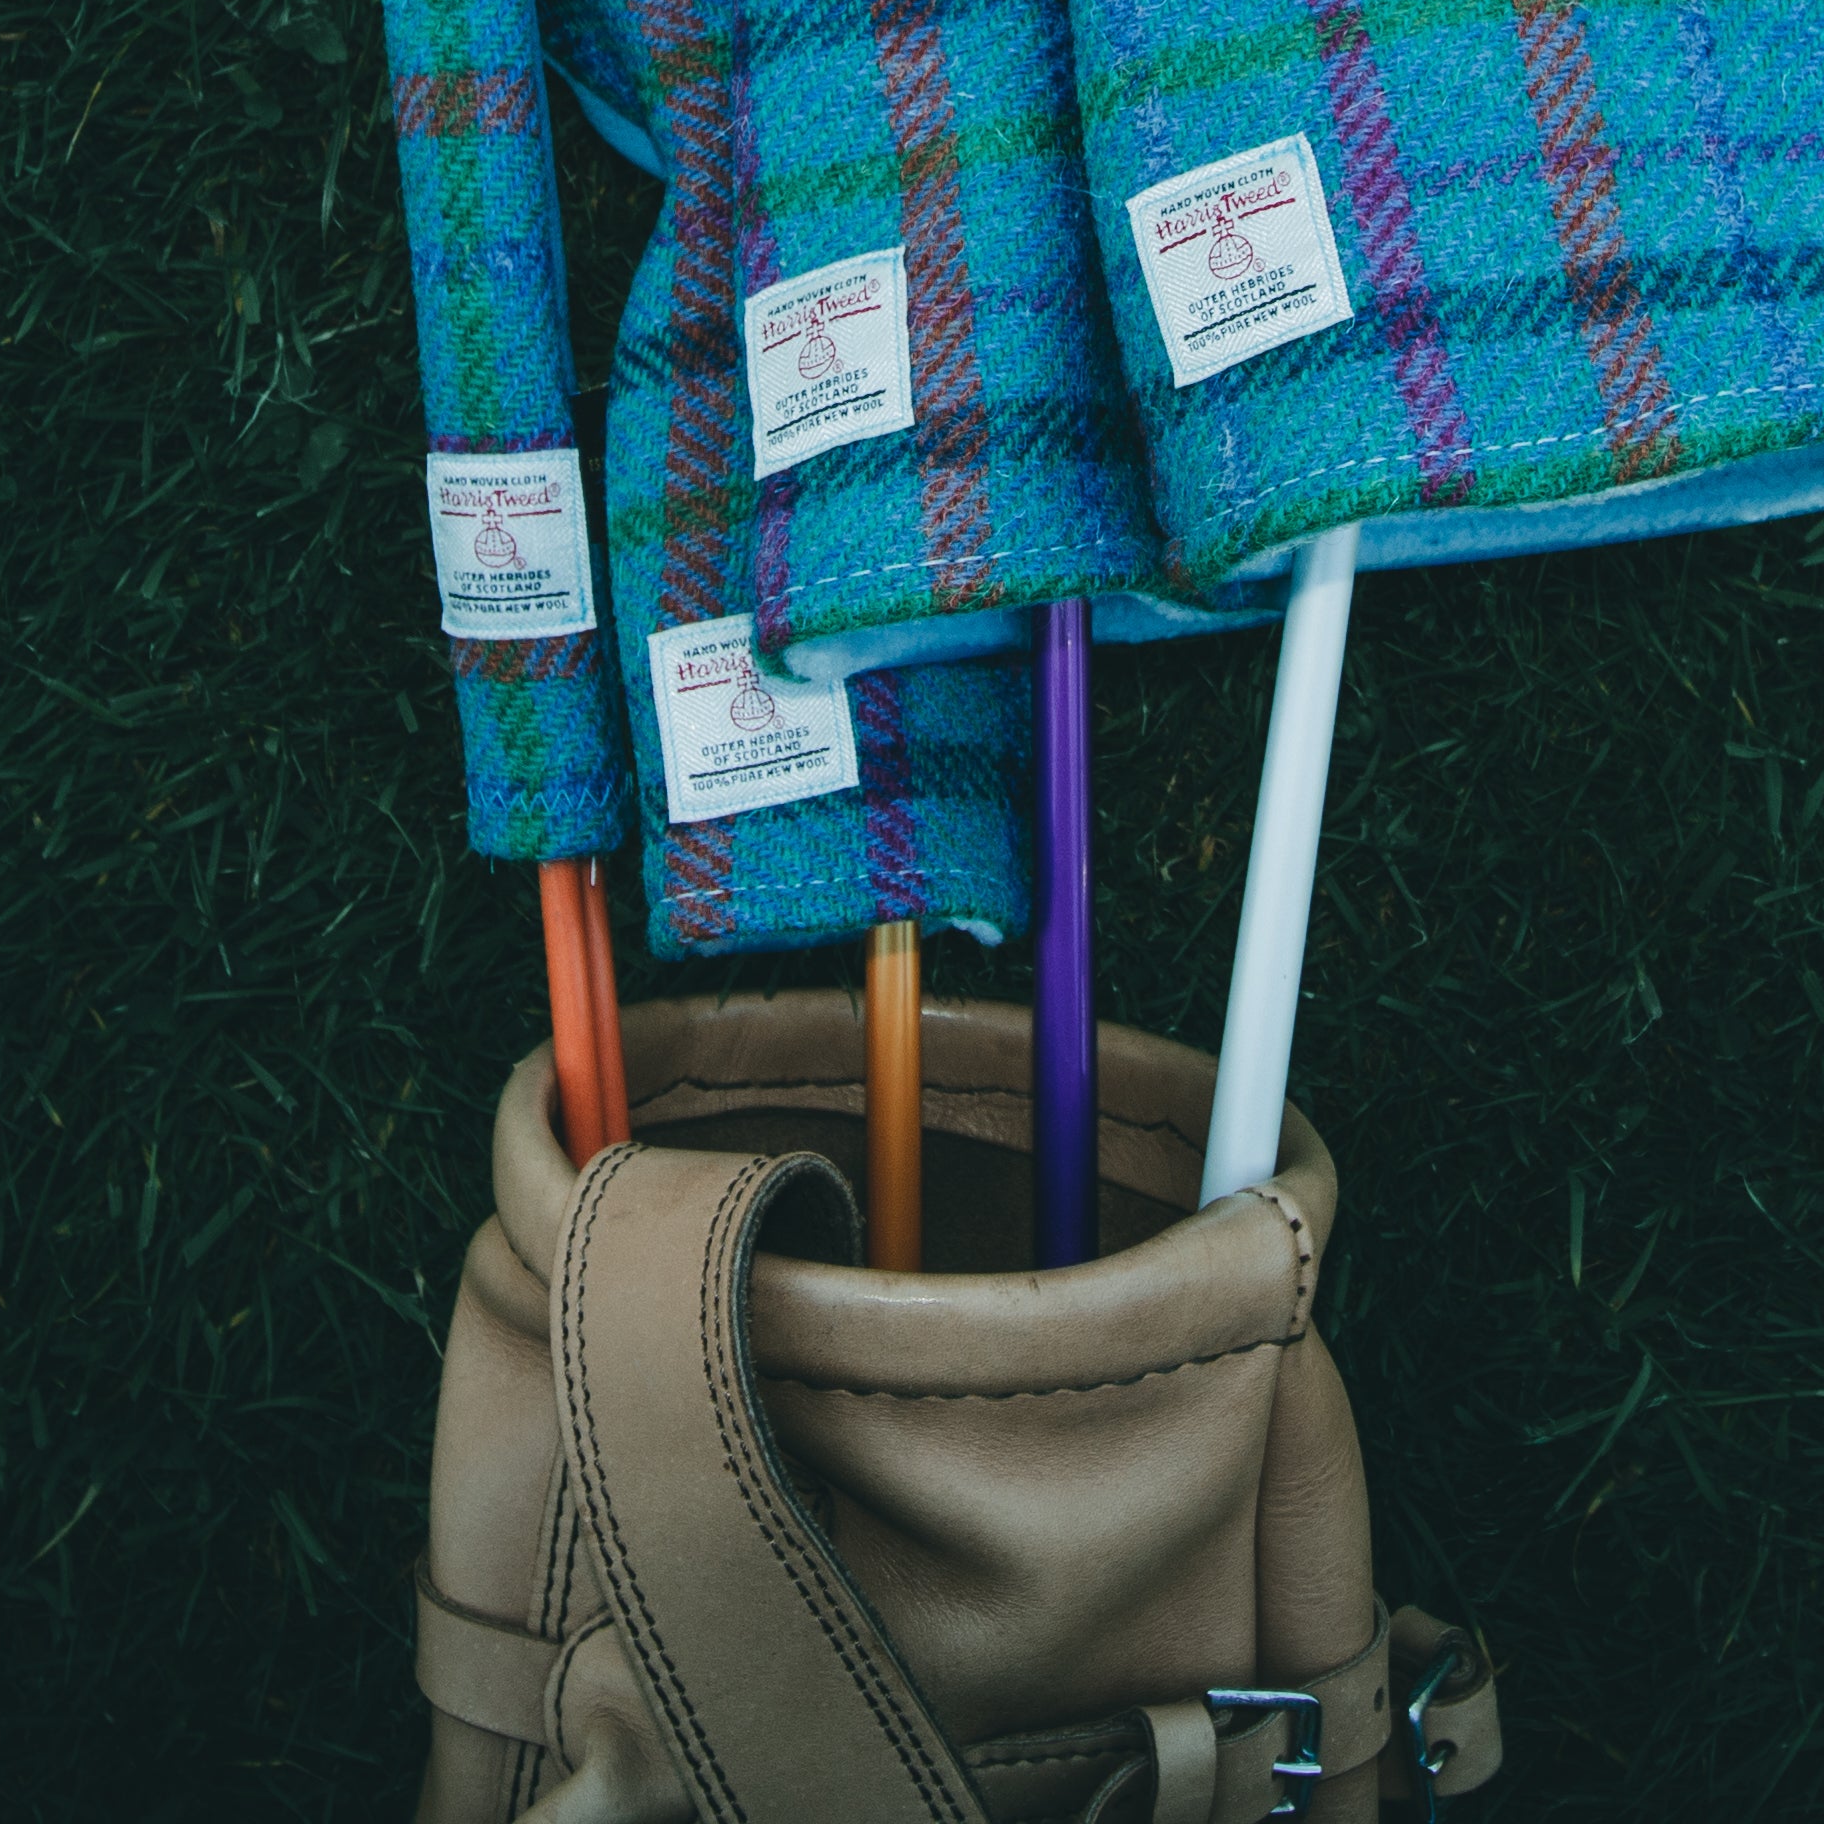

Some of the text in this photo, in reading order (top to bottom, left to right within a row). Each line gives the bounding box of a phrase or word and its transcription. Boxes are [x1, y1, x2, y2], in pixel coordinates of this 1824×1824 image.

[1161, 167, 1274, 216] HAND WOVEN CLOTH
[1155, 202, 1222, 240] Harris
[768, 274, 867, 317] HAND WOVEN CLOTH
[1188, 264, 1295, 315] OUTER HEBRIDES
[1201, 281, 1286, 322] OF SCOTLAND
[762, 306, 816, 340] Harris
[1187, 293, 1317, 353] 100% PURE NEW WOOL
[775, 368, 868, 411] OUTER HEBRIDES
[784, 384, 859, 419] OF SCOTLAND
[796, 416, 821, 436] PURE
[824, 408, 849, 424] NEW
[853, 398, 884, 414] WOOL
[439, 486, 494, 507] Harris
[470, 477, 508, 486] WOVEN
[511, 474, 546, 485] CLOTH
[453, 569, 551, 582] OUTER HEBRIDES
[461, 582, 541, 594] OF SCOTLAND
[506, 603, 531, 613] NEW
[536, 599, 568, 610] WOOL
[677, 652, 748, 680] Harris
[683, 644, 717, 659] HAND
[701, 726, 810, 757] OUTER HEBRIDES
[714, 741, 801, 766] OF SCOTLAND
[692, 756, 830, 791] 100% PURE NEW WOOL
